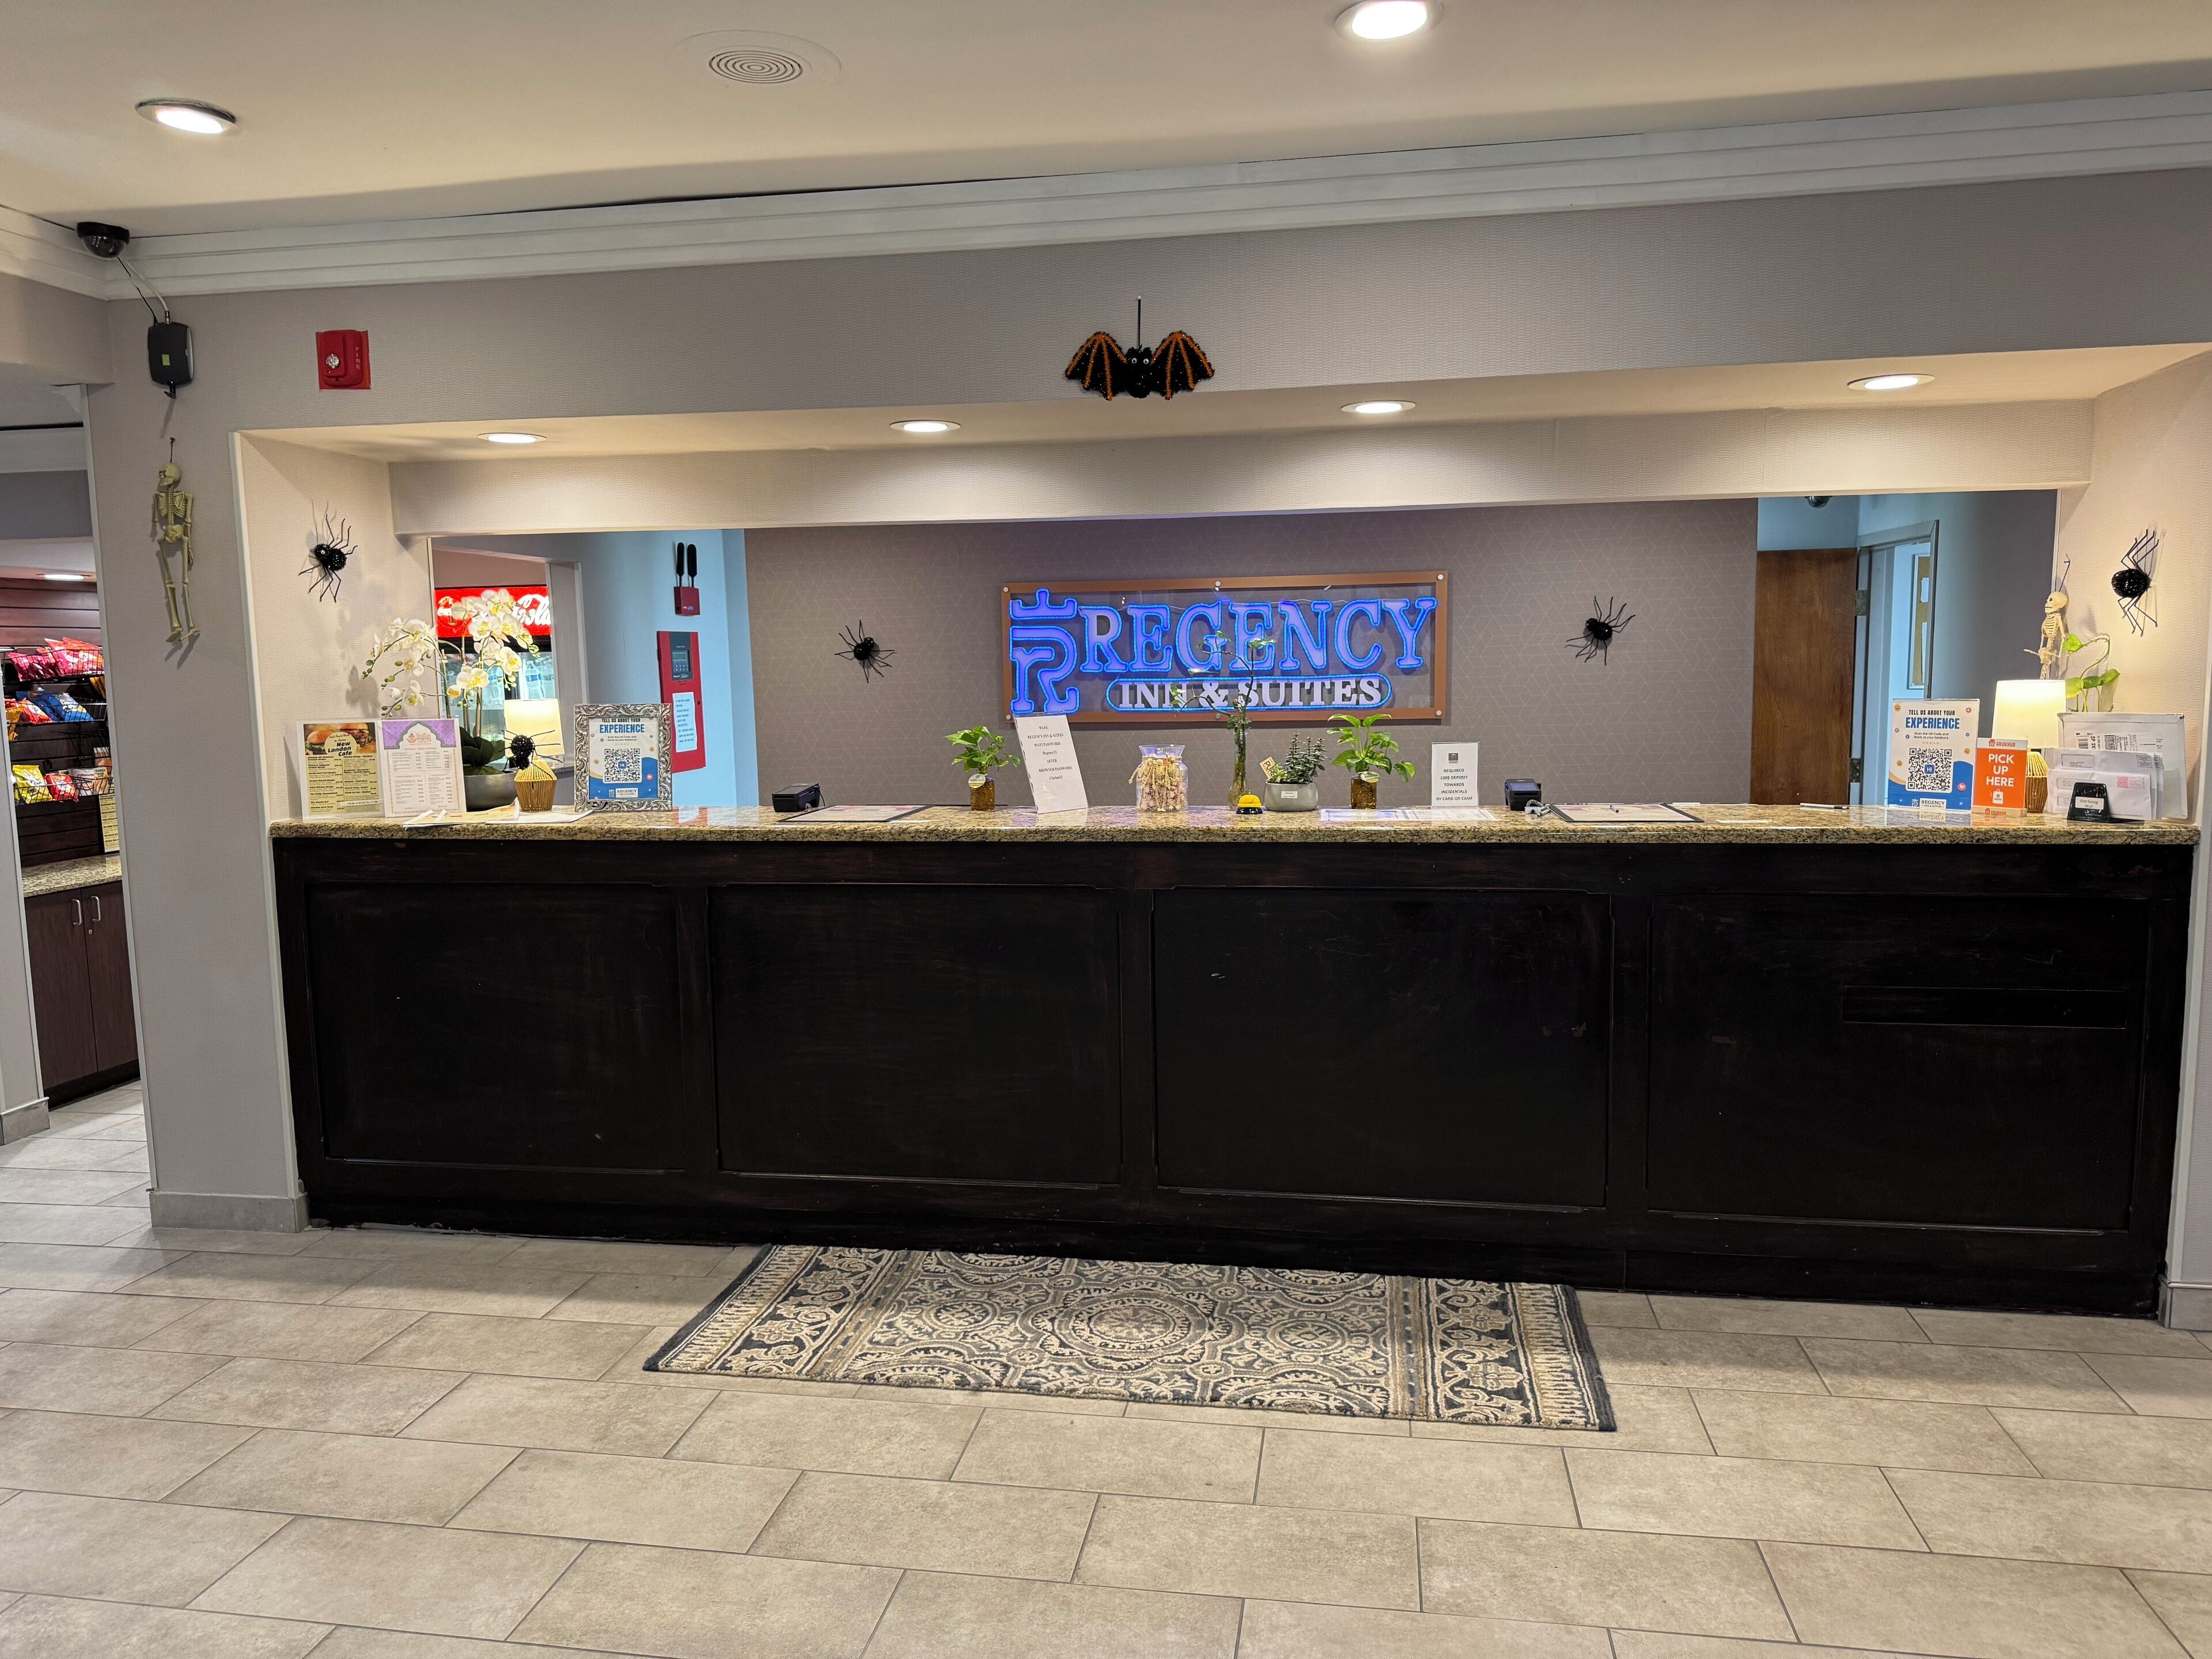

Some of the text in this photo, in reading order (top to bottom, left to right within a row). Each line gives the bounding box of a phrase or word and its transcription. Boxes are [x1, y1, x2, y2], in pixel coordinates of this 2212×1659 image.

[1078, 596, 1438, 673] REGENCY
[1119, 677, 1382, 709] INN & SUITES
[600, 724, 645, 733] EXPERIENCE
[1905, 717, 1960, 729] EXPERIENCE
[1988, 753, 2014, 764] PICK
[1993, 765, 2009, 775] UP
[1986, 776, 2014, 787] HERE
